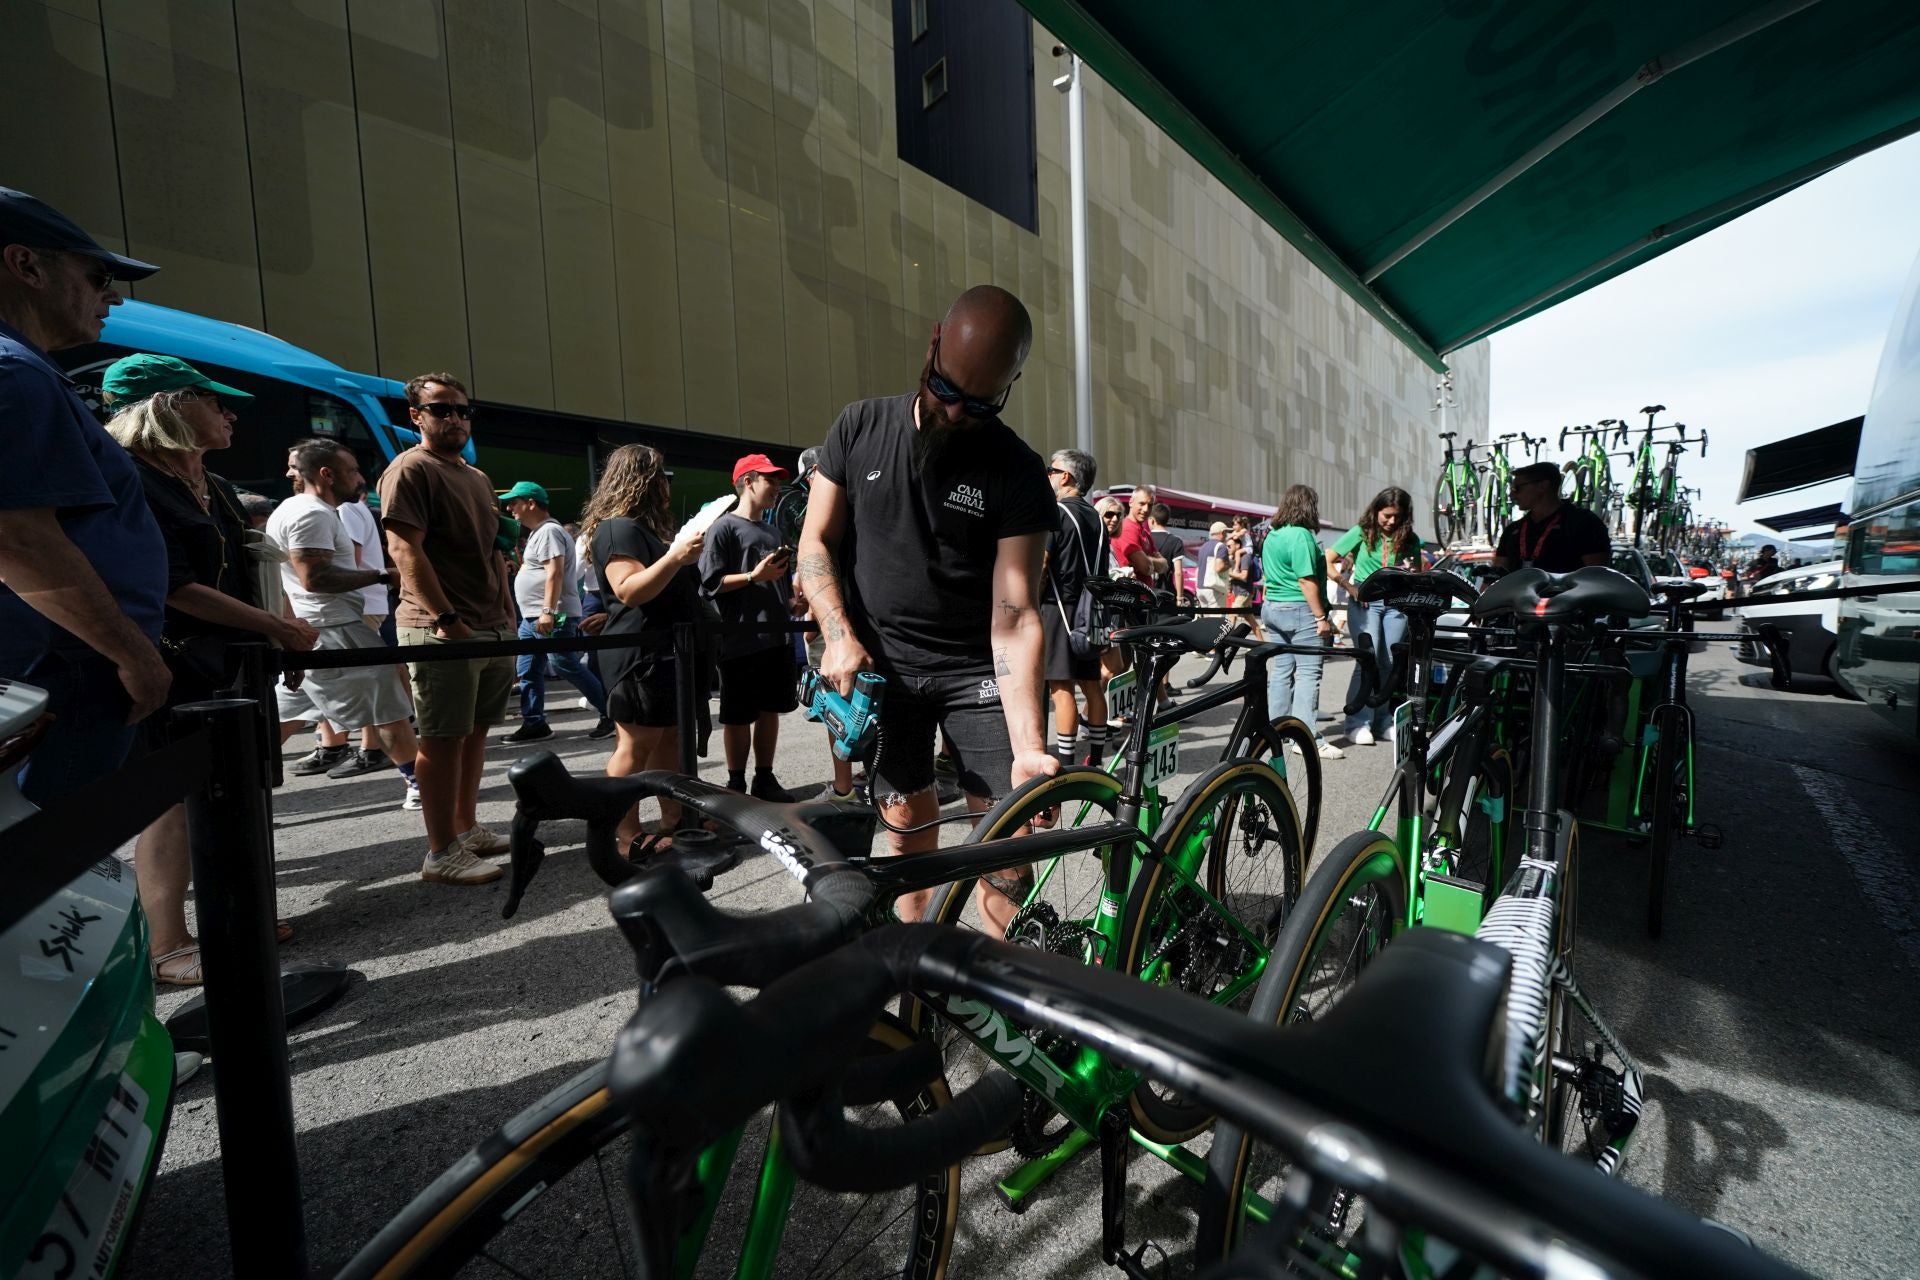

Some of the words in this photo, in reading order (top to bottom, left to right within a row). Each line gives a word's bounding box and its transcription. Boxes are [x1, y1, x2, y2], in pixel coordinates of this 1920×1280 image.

[947, 491, 985, 511] RURAL
[957, 484, 983, 500] CAJA
[1112, 685, 1134, 719] 144
[1396, 722, 1410, 764] 142
[1150, 740, 1178, 783] 143
